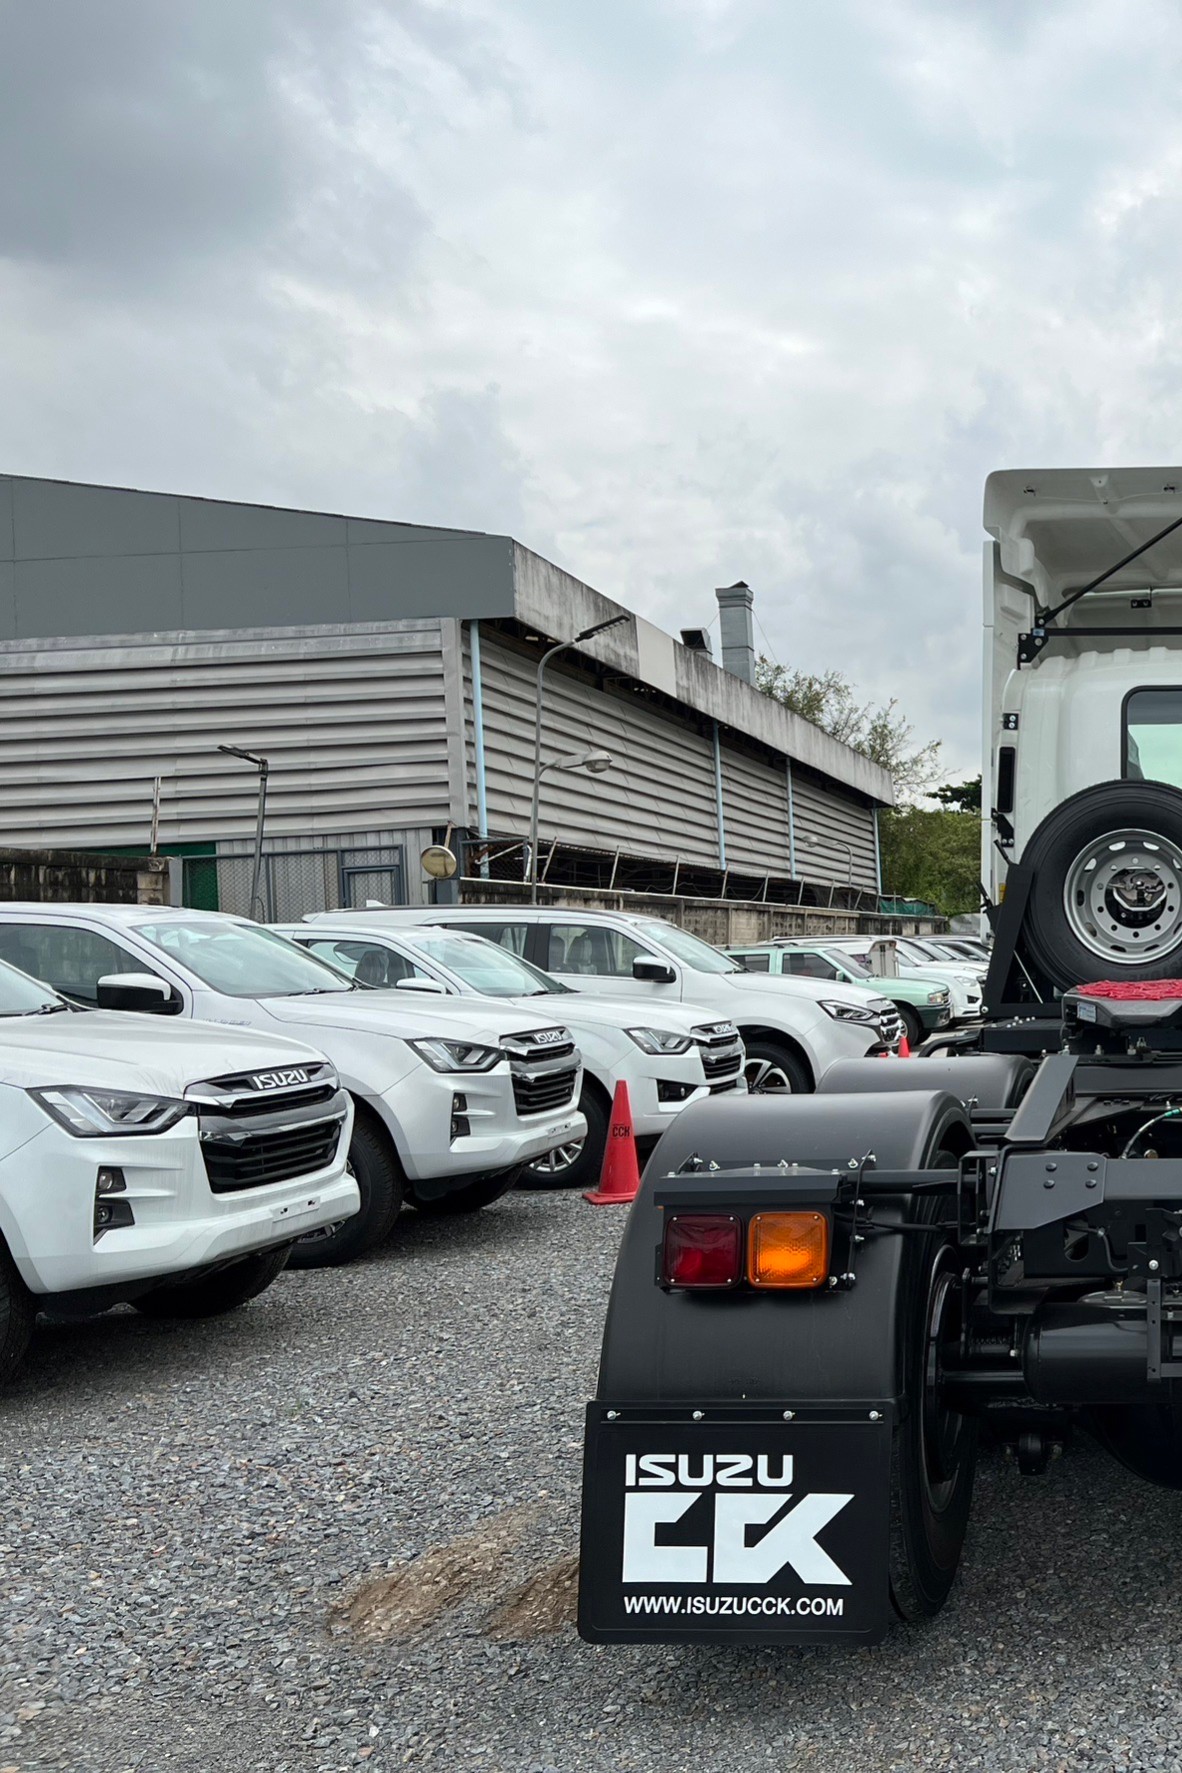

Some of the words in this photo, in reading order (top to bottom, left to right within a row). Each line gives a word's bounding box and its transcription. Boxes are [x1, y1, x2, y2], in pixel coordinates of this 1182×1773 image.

[534, 1031, 562, 1044] ISUZU
[252, 1069, 309, 1090] ISUZU
[625, 1453, 794, 1487] ISUZU
[621, 1491, 855, 1586] CCK
[623, 1595, 844, 1616] WWW.ISUZUCCK.COM
